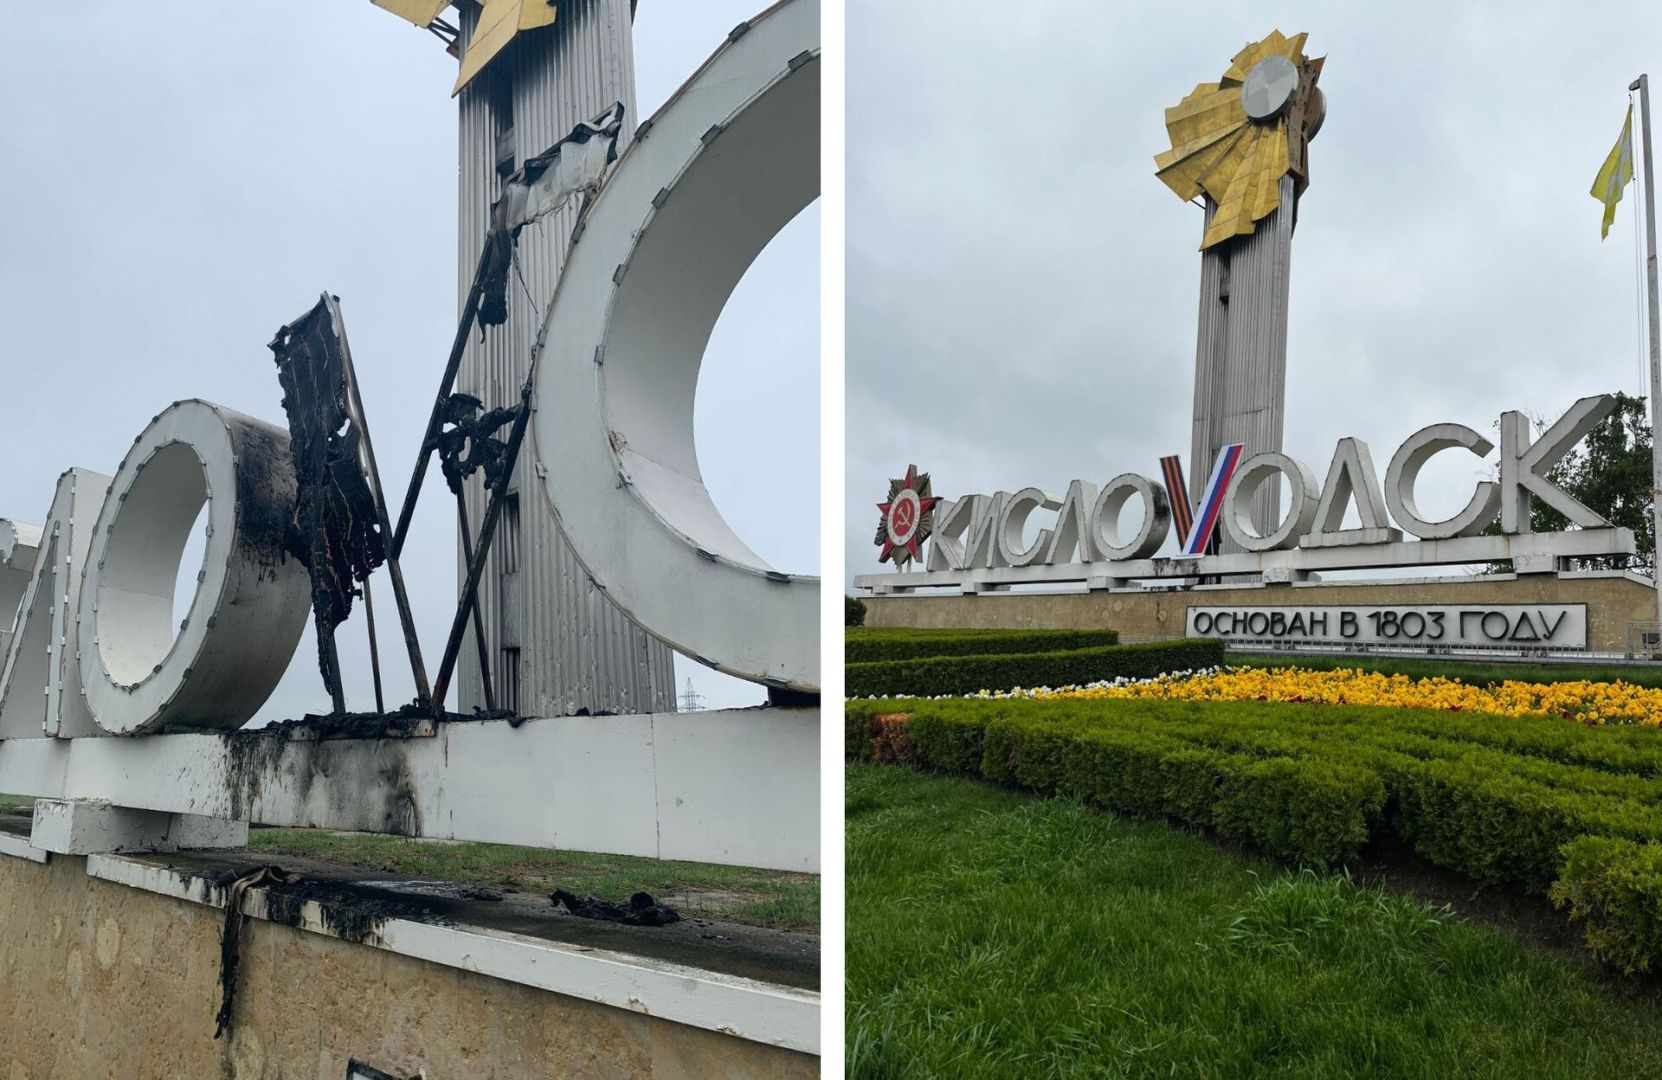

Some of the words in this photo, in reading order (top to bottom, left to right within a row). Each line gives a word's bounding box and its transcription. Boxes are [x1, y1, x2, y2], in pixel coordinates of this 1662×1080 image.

[1194, 611, 1327, 636] ОСНОВАН
[1340, 611, 1359, 638] В
[1367, 611, 1445, 638] 1803
[1460, 610, 1567, 641] ГОДУ
